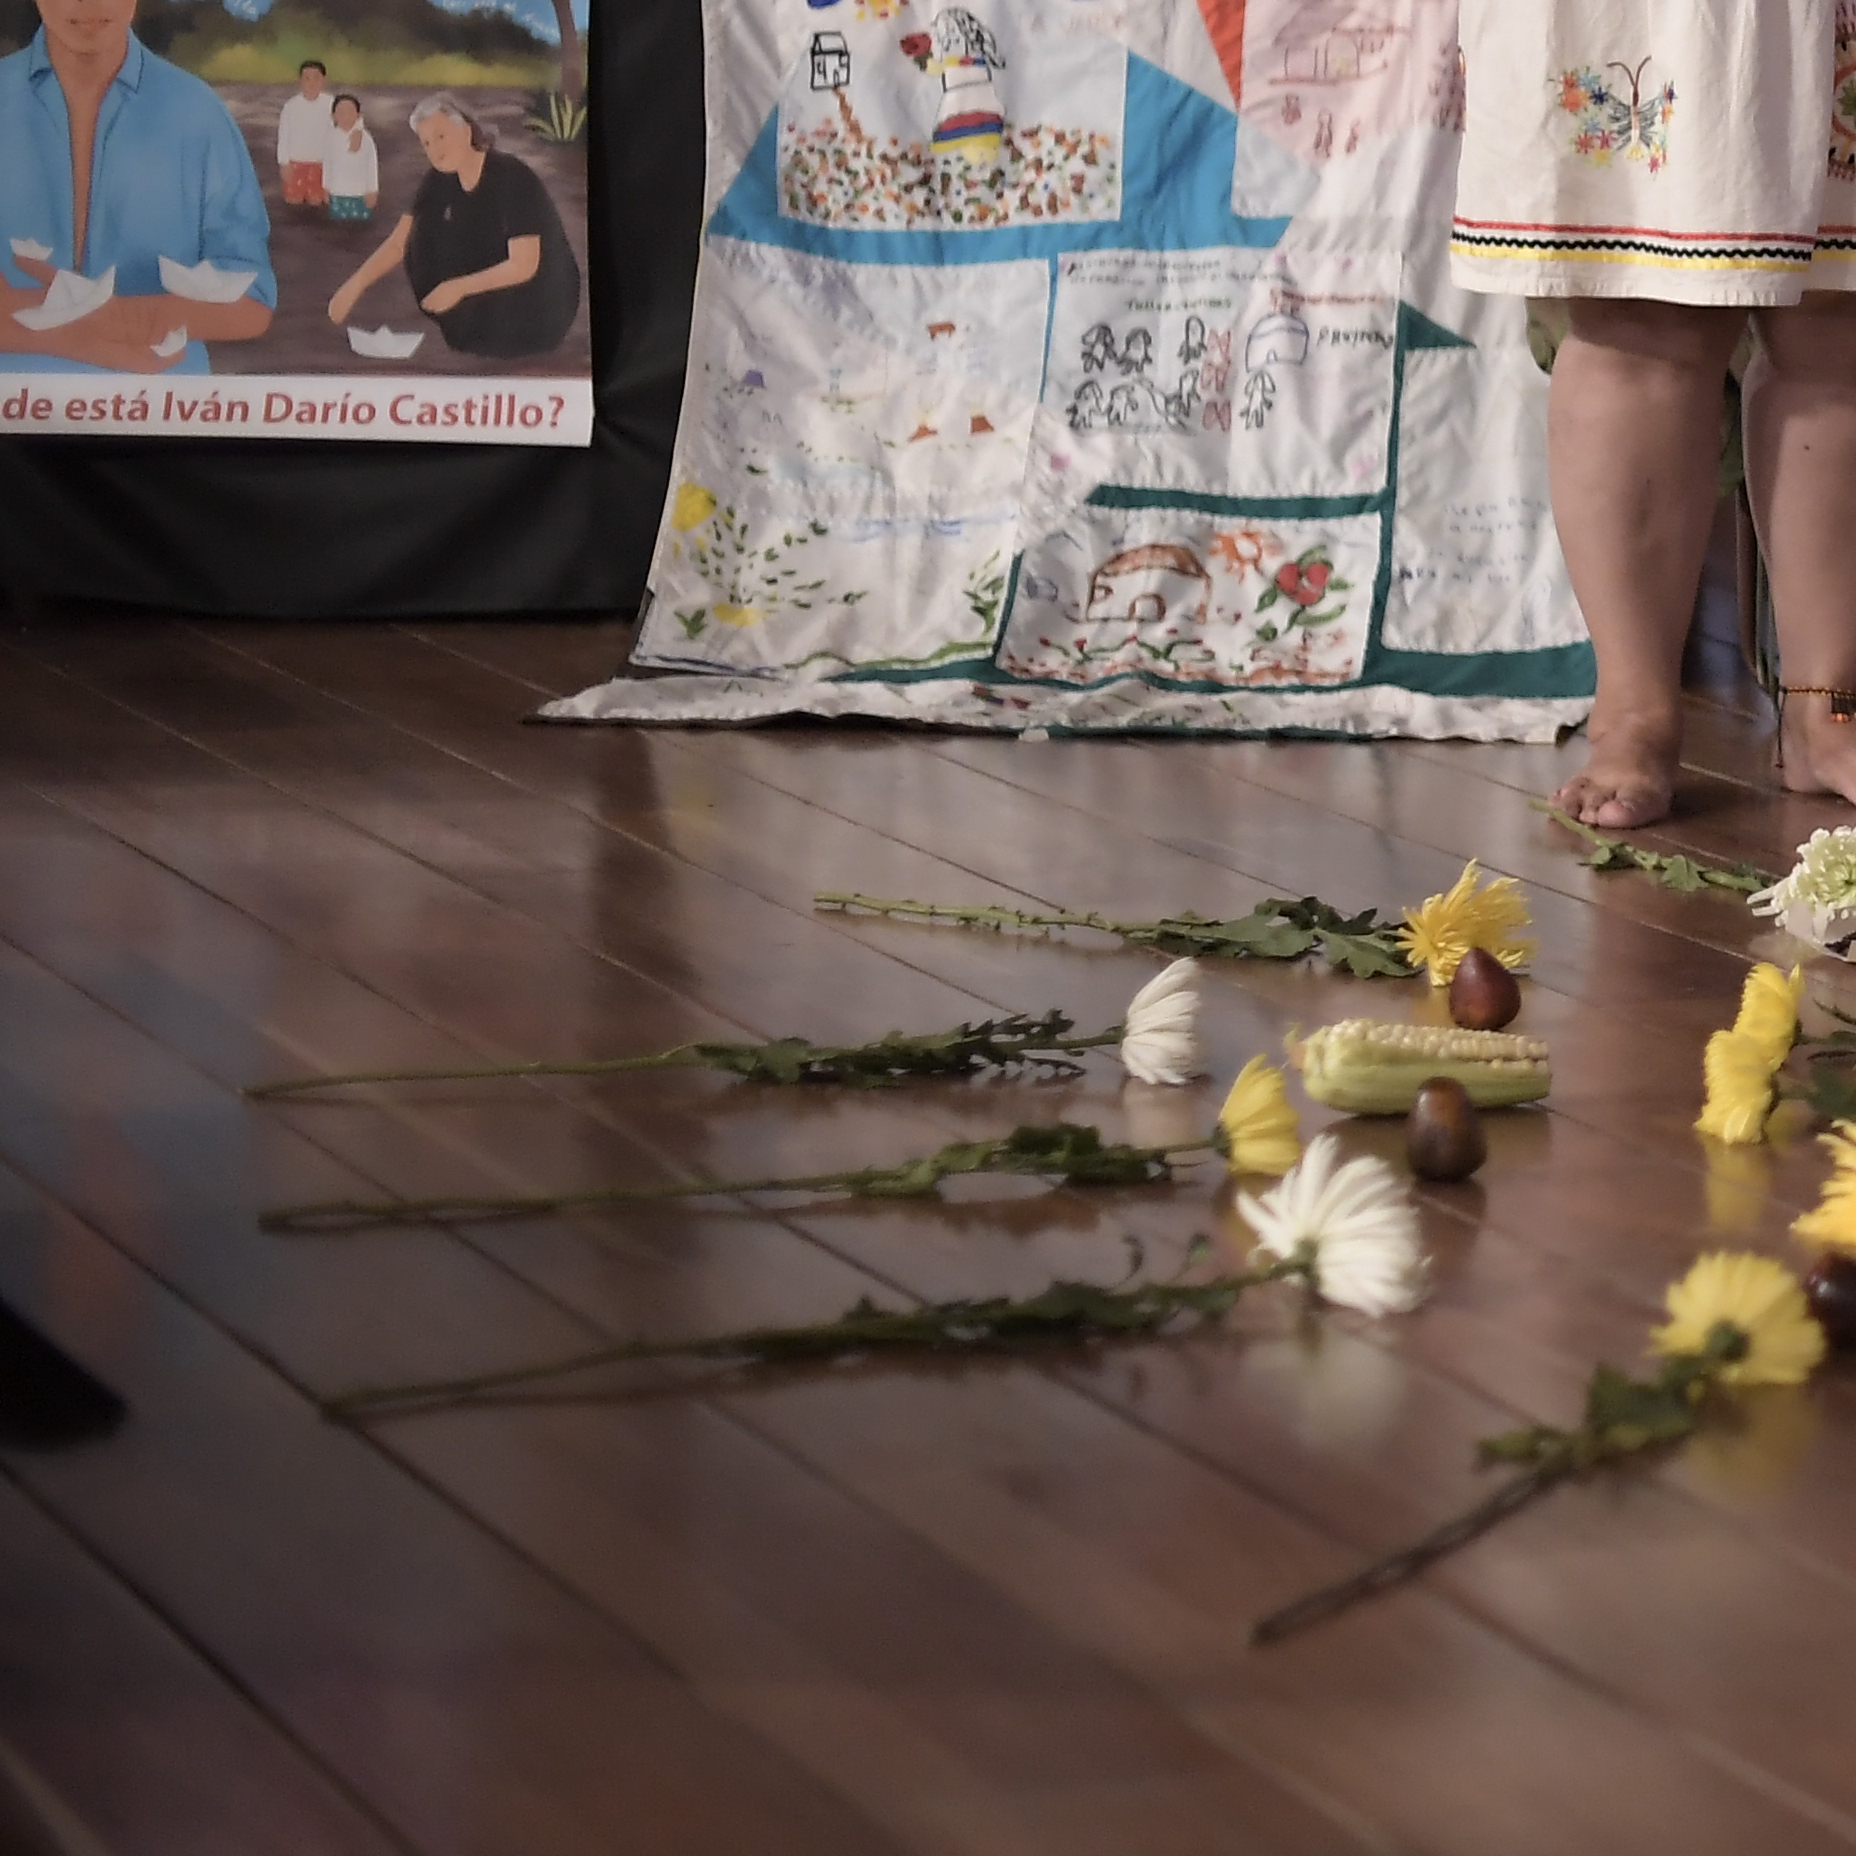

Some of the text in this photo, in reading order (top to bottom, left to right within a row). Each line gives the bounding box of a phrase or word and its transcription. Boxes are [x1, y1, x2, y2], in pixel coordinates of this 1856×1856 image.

[2, 387, 565, 429] de está Iván Darío Castillo?
